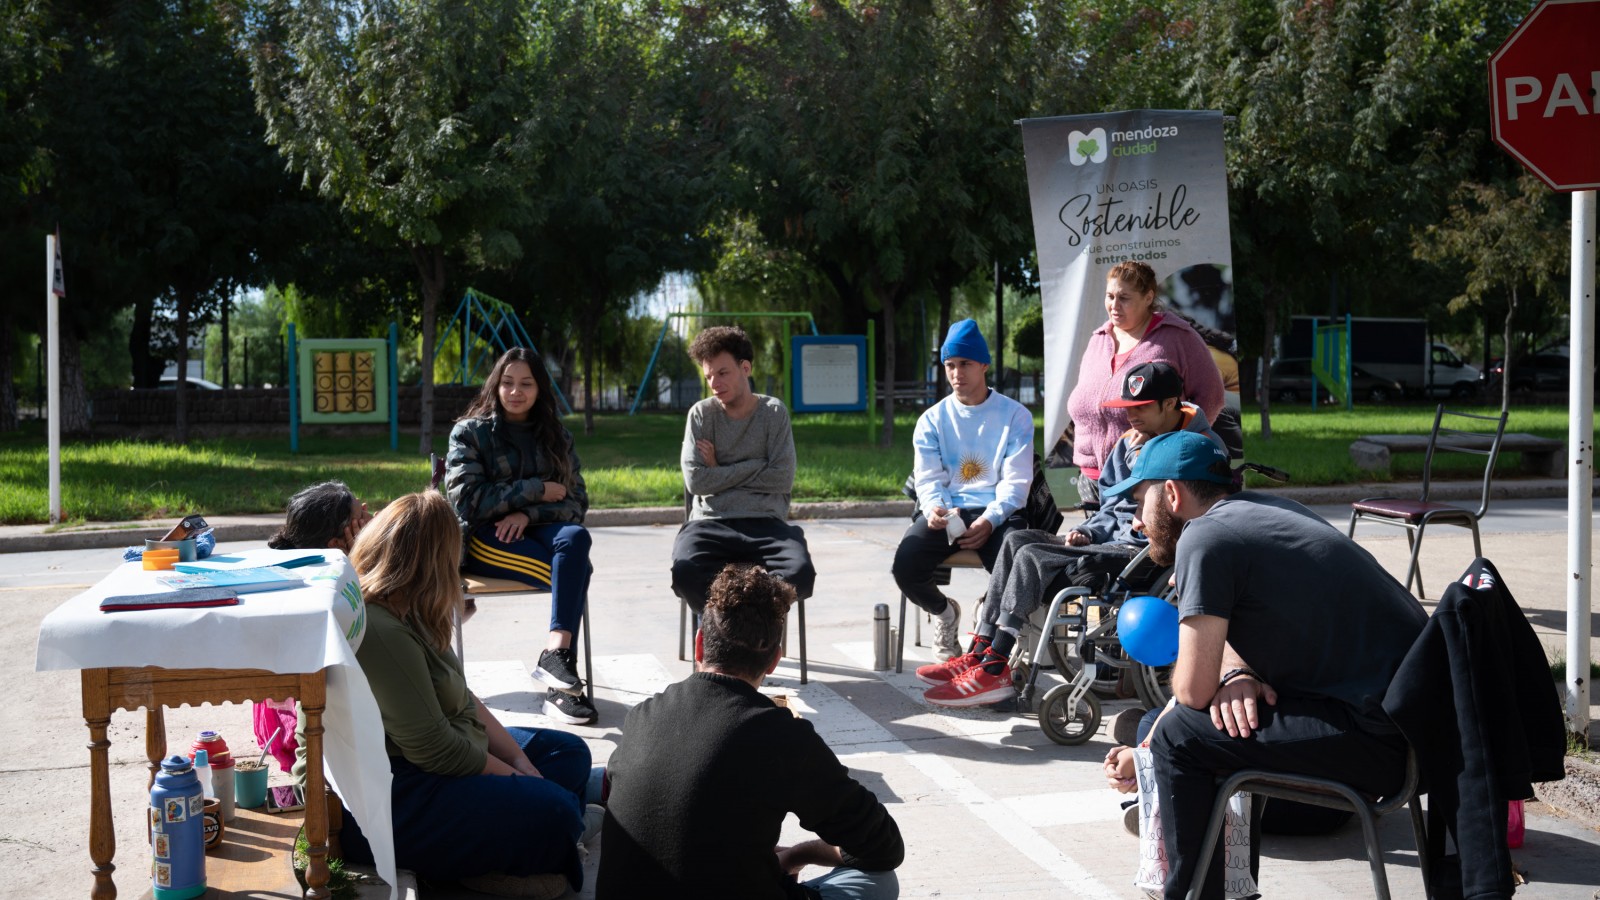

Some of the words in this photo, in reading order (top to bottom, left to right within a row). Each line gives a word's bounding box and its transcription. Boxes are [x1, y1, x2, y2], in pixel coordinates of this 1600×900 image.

[1505, 71, 1600, 121] PA
[1111, 125, 1178, 142] mendoza
[1112, 140, 1157, 157] ciudad
[1096, 183, 1114, 195] UN
[1118, 179, 1158, 193] OASIS
[1059, 184, 1200, 247] Sostenible
[1083, 245, 1102, 257] que
[1105, 238, 1181, 252] construimos
[1095, 254, 1128, 265] entre
[1131, 251, 1167, 262] todos
[203, 825, 219, 833] LVO
